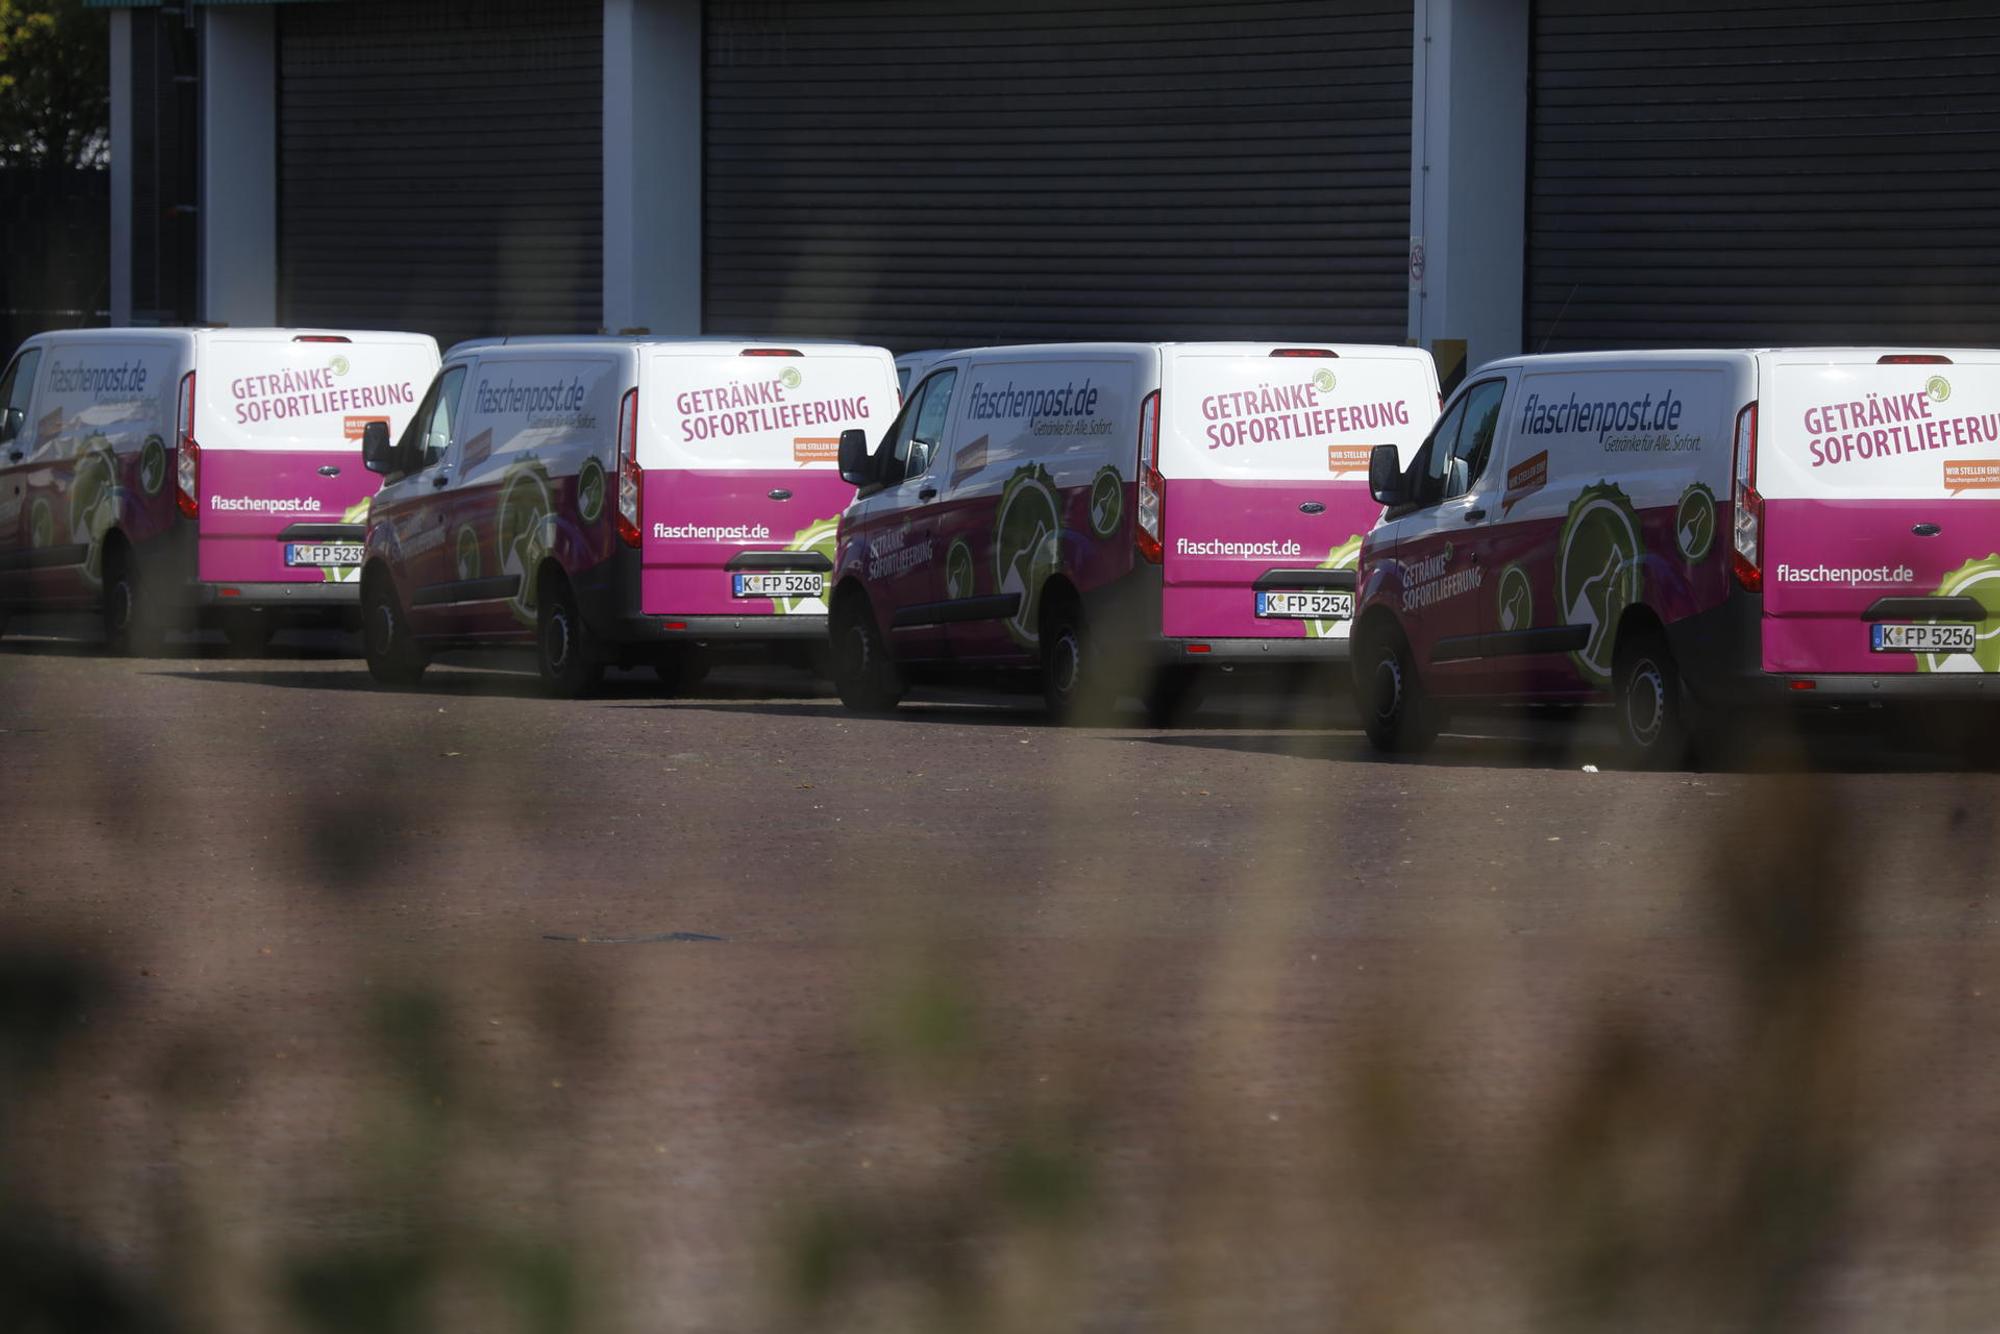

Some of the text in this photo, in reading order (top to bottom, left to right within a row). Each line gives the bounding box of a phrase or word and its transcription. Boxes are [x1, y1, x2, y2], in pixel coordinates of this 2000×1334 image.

[50, 359, 147, 400] flaschenpost.de
[231, 368, 334, 399] GETRÄNKE
[235, 382, 414, 424] SOFORTLIEFERUNG
[476, 376, 584, 420] flaschenpost.de
[677, 380, 785, 415] GETRÄNKE
[968, 378, 1098, 427] flaschenpost.de
[1201, 383, 1319, 421] GETRÄNKE
[1804, 391, 1931, 435] GETRÄNKE
[680, 396, 870, 442] SOFORTLIEFERUNG
[1206, 400, 1409, 450] SOFORTLIEFERUNG
[1521, 389, 1682, 443] flaschenpost.de
[1808, 413, 2000, 467] SOFORTLIEFERU
[1960, 466, 1985, 475] STELLEN
[211, 496, 320, 513] flaschenpost.de
[653, 523, 769, 541] flaschenpost.de
[1177, 539, 1300, 558] flaschenpost.de
[295, 547, 304, 561] K
[313, 547, 331, 561] FP
[1403, 554, 1446, 588] GETRÄNKE
[744, 577, 820, 591] K FP 5268
[1402, 566, 1481, 612] SOFORTLIEFERUNG
[1777, 564, 1913, 585] flaschenpost.de
[1267, 595, 1349, 612] K FP 5254
[1883, 627, 1973, 645] K FP 5256
